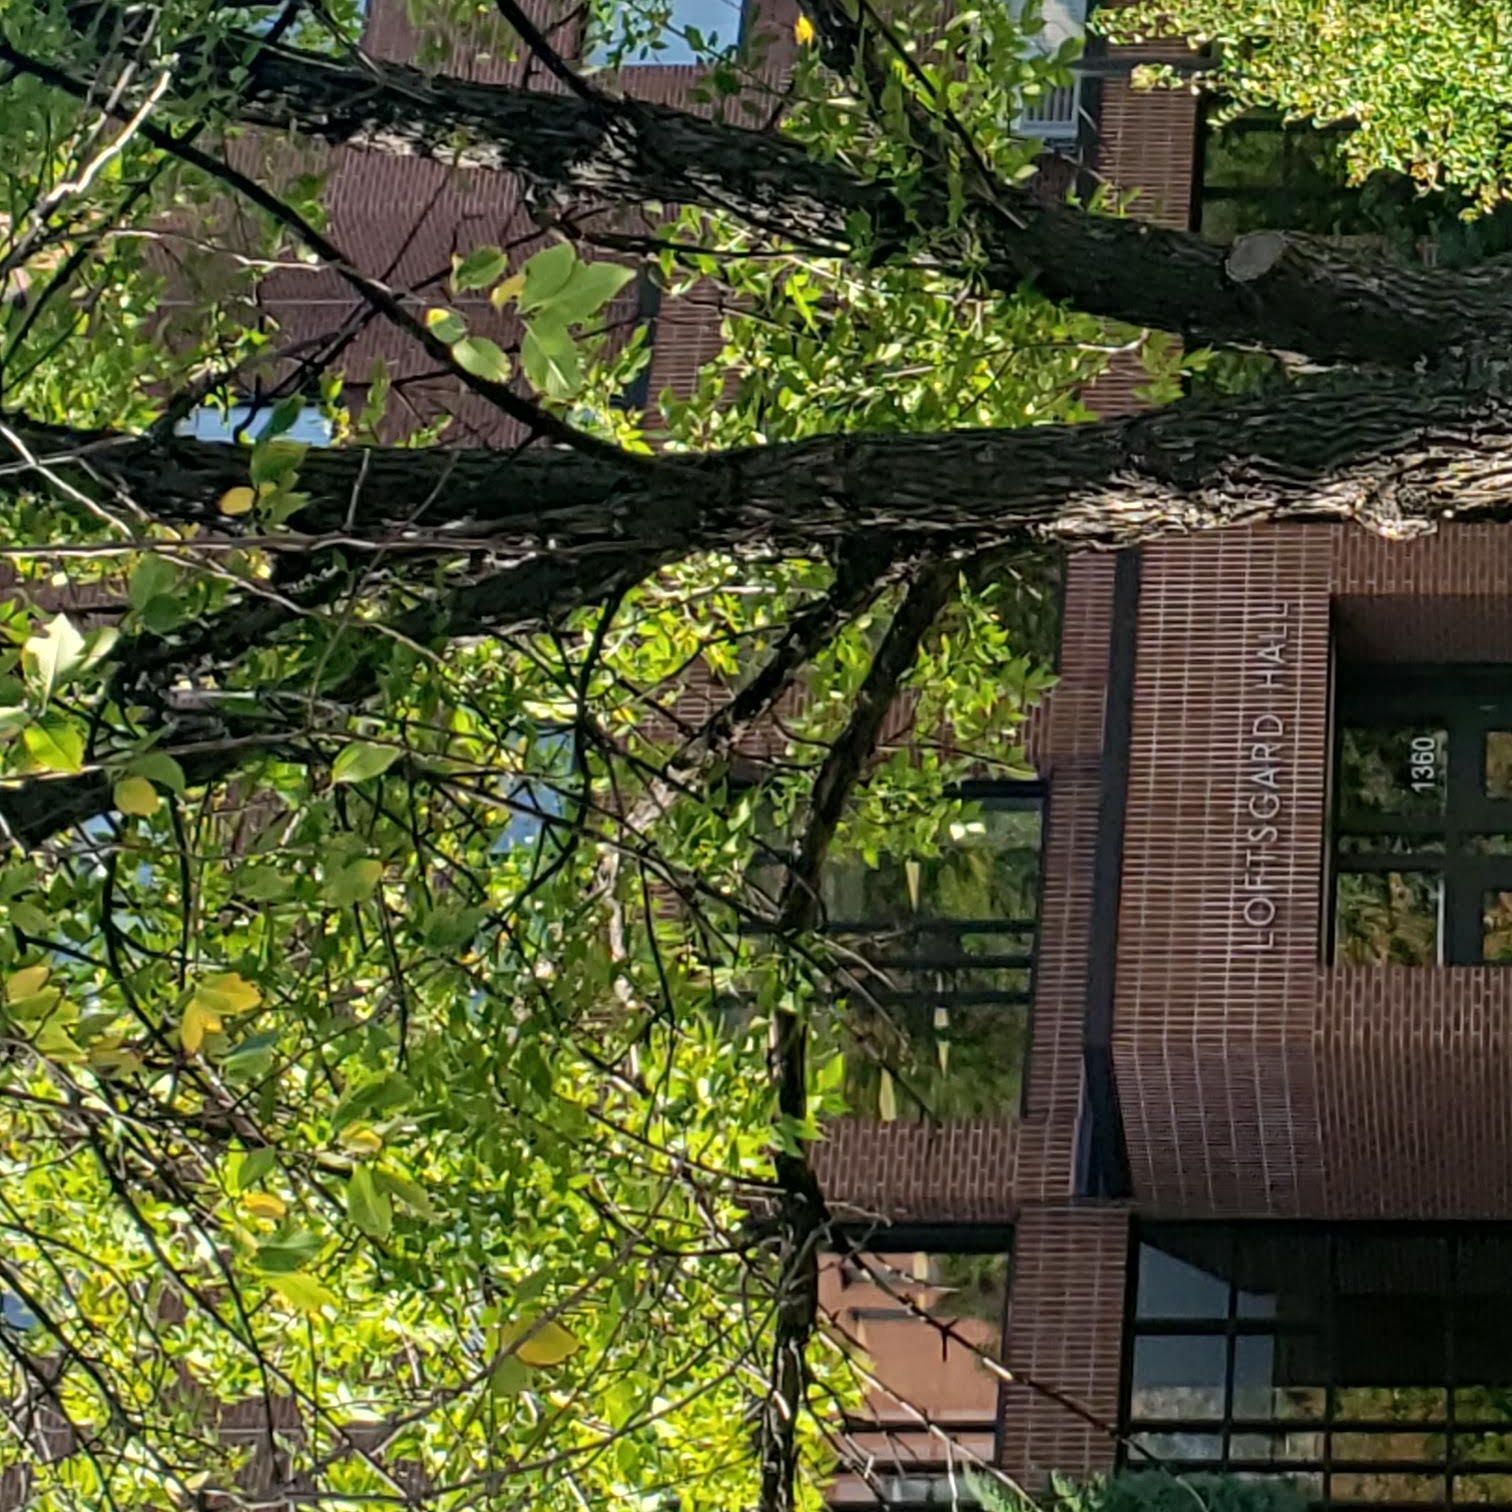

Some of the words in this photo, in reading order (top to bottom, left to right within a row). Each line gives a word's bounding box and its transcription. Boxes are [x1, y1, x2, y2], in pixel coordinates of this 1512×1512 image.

[1253, 600, 1290, 689] HALL
[1410, 737, 1436, 792] 1360
[1240, 714, 1284, 950] LOFTSGARD
